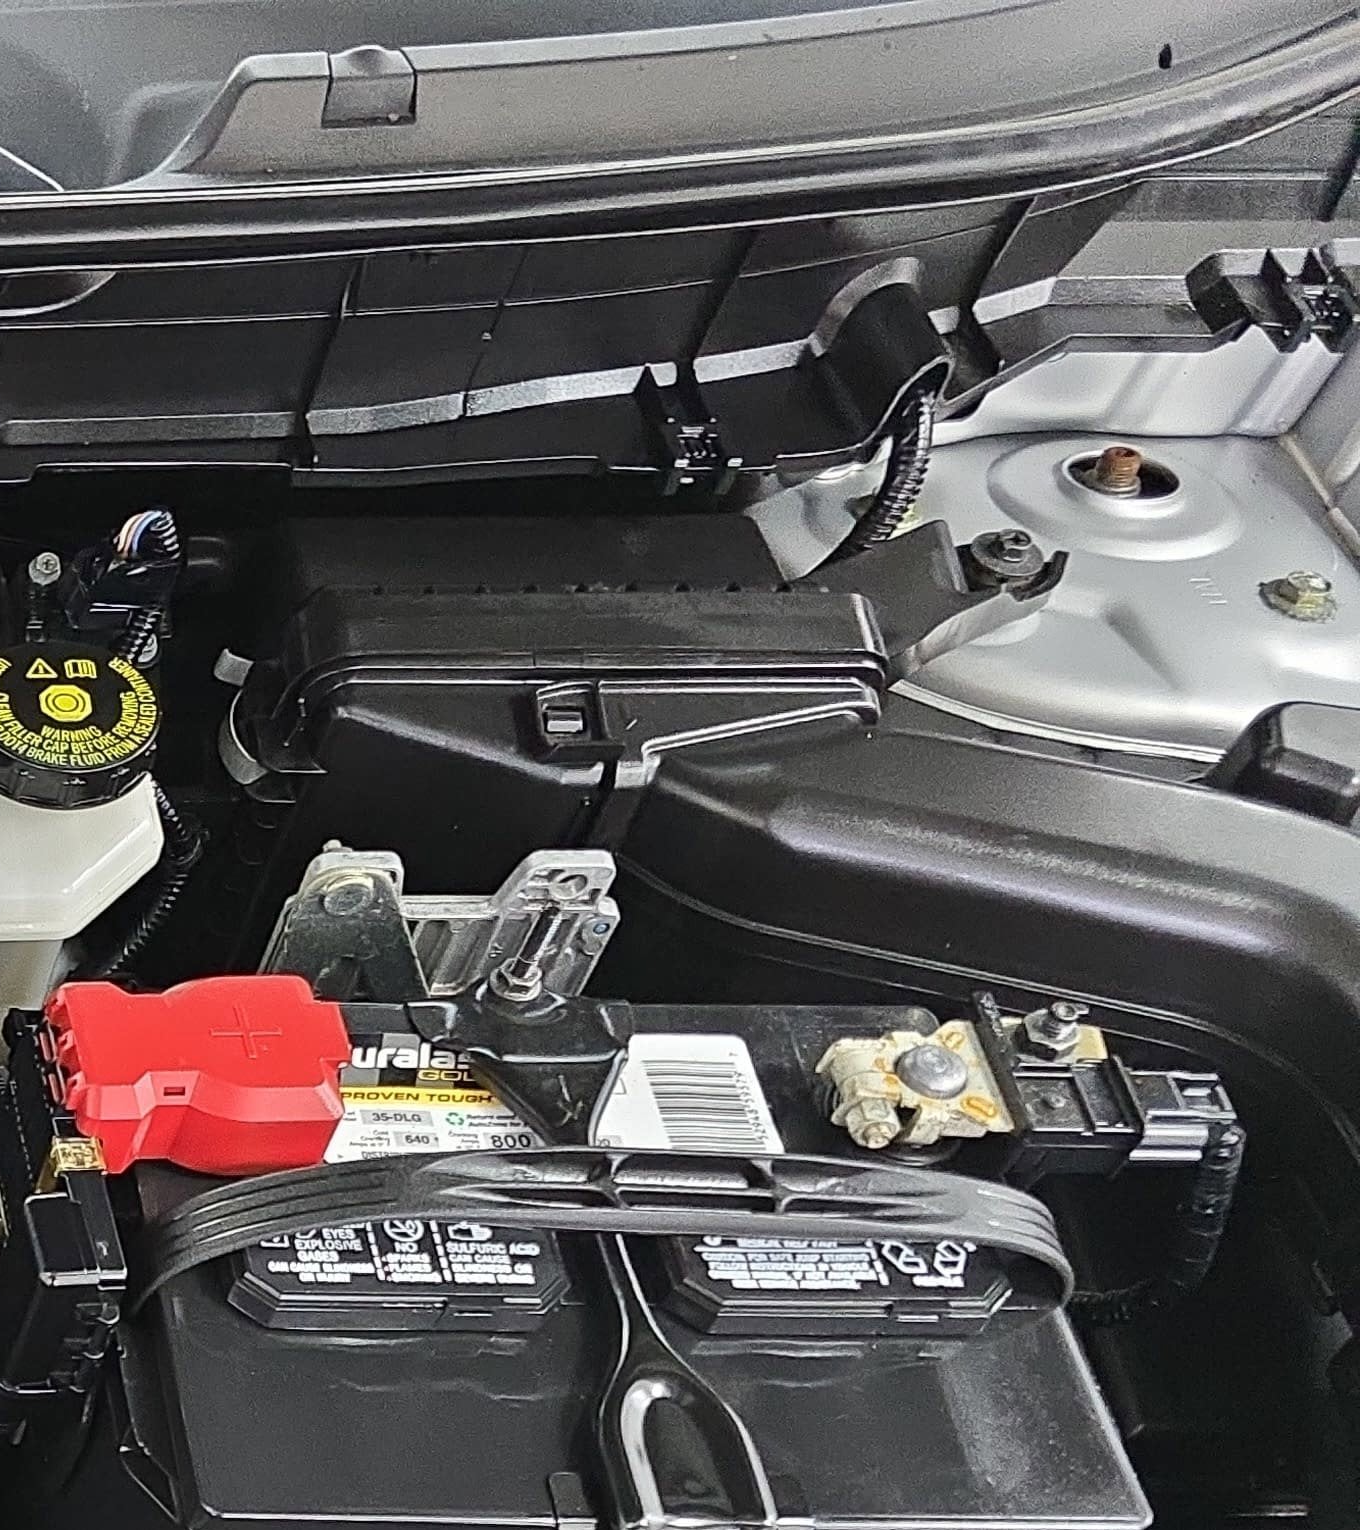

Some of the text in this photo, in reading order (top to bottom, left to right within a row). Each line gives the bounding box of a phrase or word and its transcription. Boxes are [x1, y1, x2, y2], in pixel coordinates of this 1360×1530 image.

[108, 657, 156, 702] CONTAINER
[4, 720, 43, 747] FILLER
[42, 740, 69, 753] CAP
[71, 732, 120, 754] BEFORE
[112, 691, 138, 738] REMOVING
[134, 703, 157, 737] SEALED
[41, 725, 102, 742] WARNING
[26, 747, 68, 766] BRAKE
[103, 738, 138, 761] FROM
[69, 752, 106, 767] FLUID
[338, 1042, 472, 1069] urala
[417, 1069, 477, 1082] GOL
[341, 1091, 493, 1104] PROVEN TOUGH
[491, 1134, 531, 1148] 800
[322, 1228, 356, 1239] EYES
[294, 1239, 363, 1250] EXPLOSIVE
[395, 1242, 418, 1252] NO
[445, 1241, 540, 1256] SULFURIC ACID
